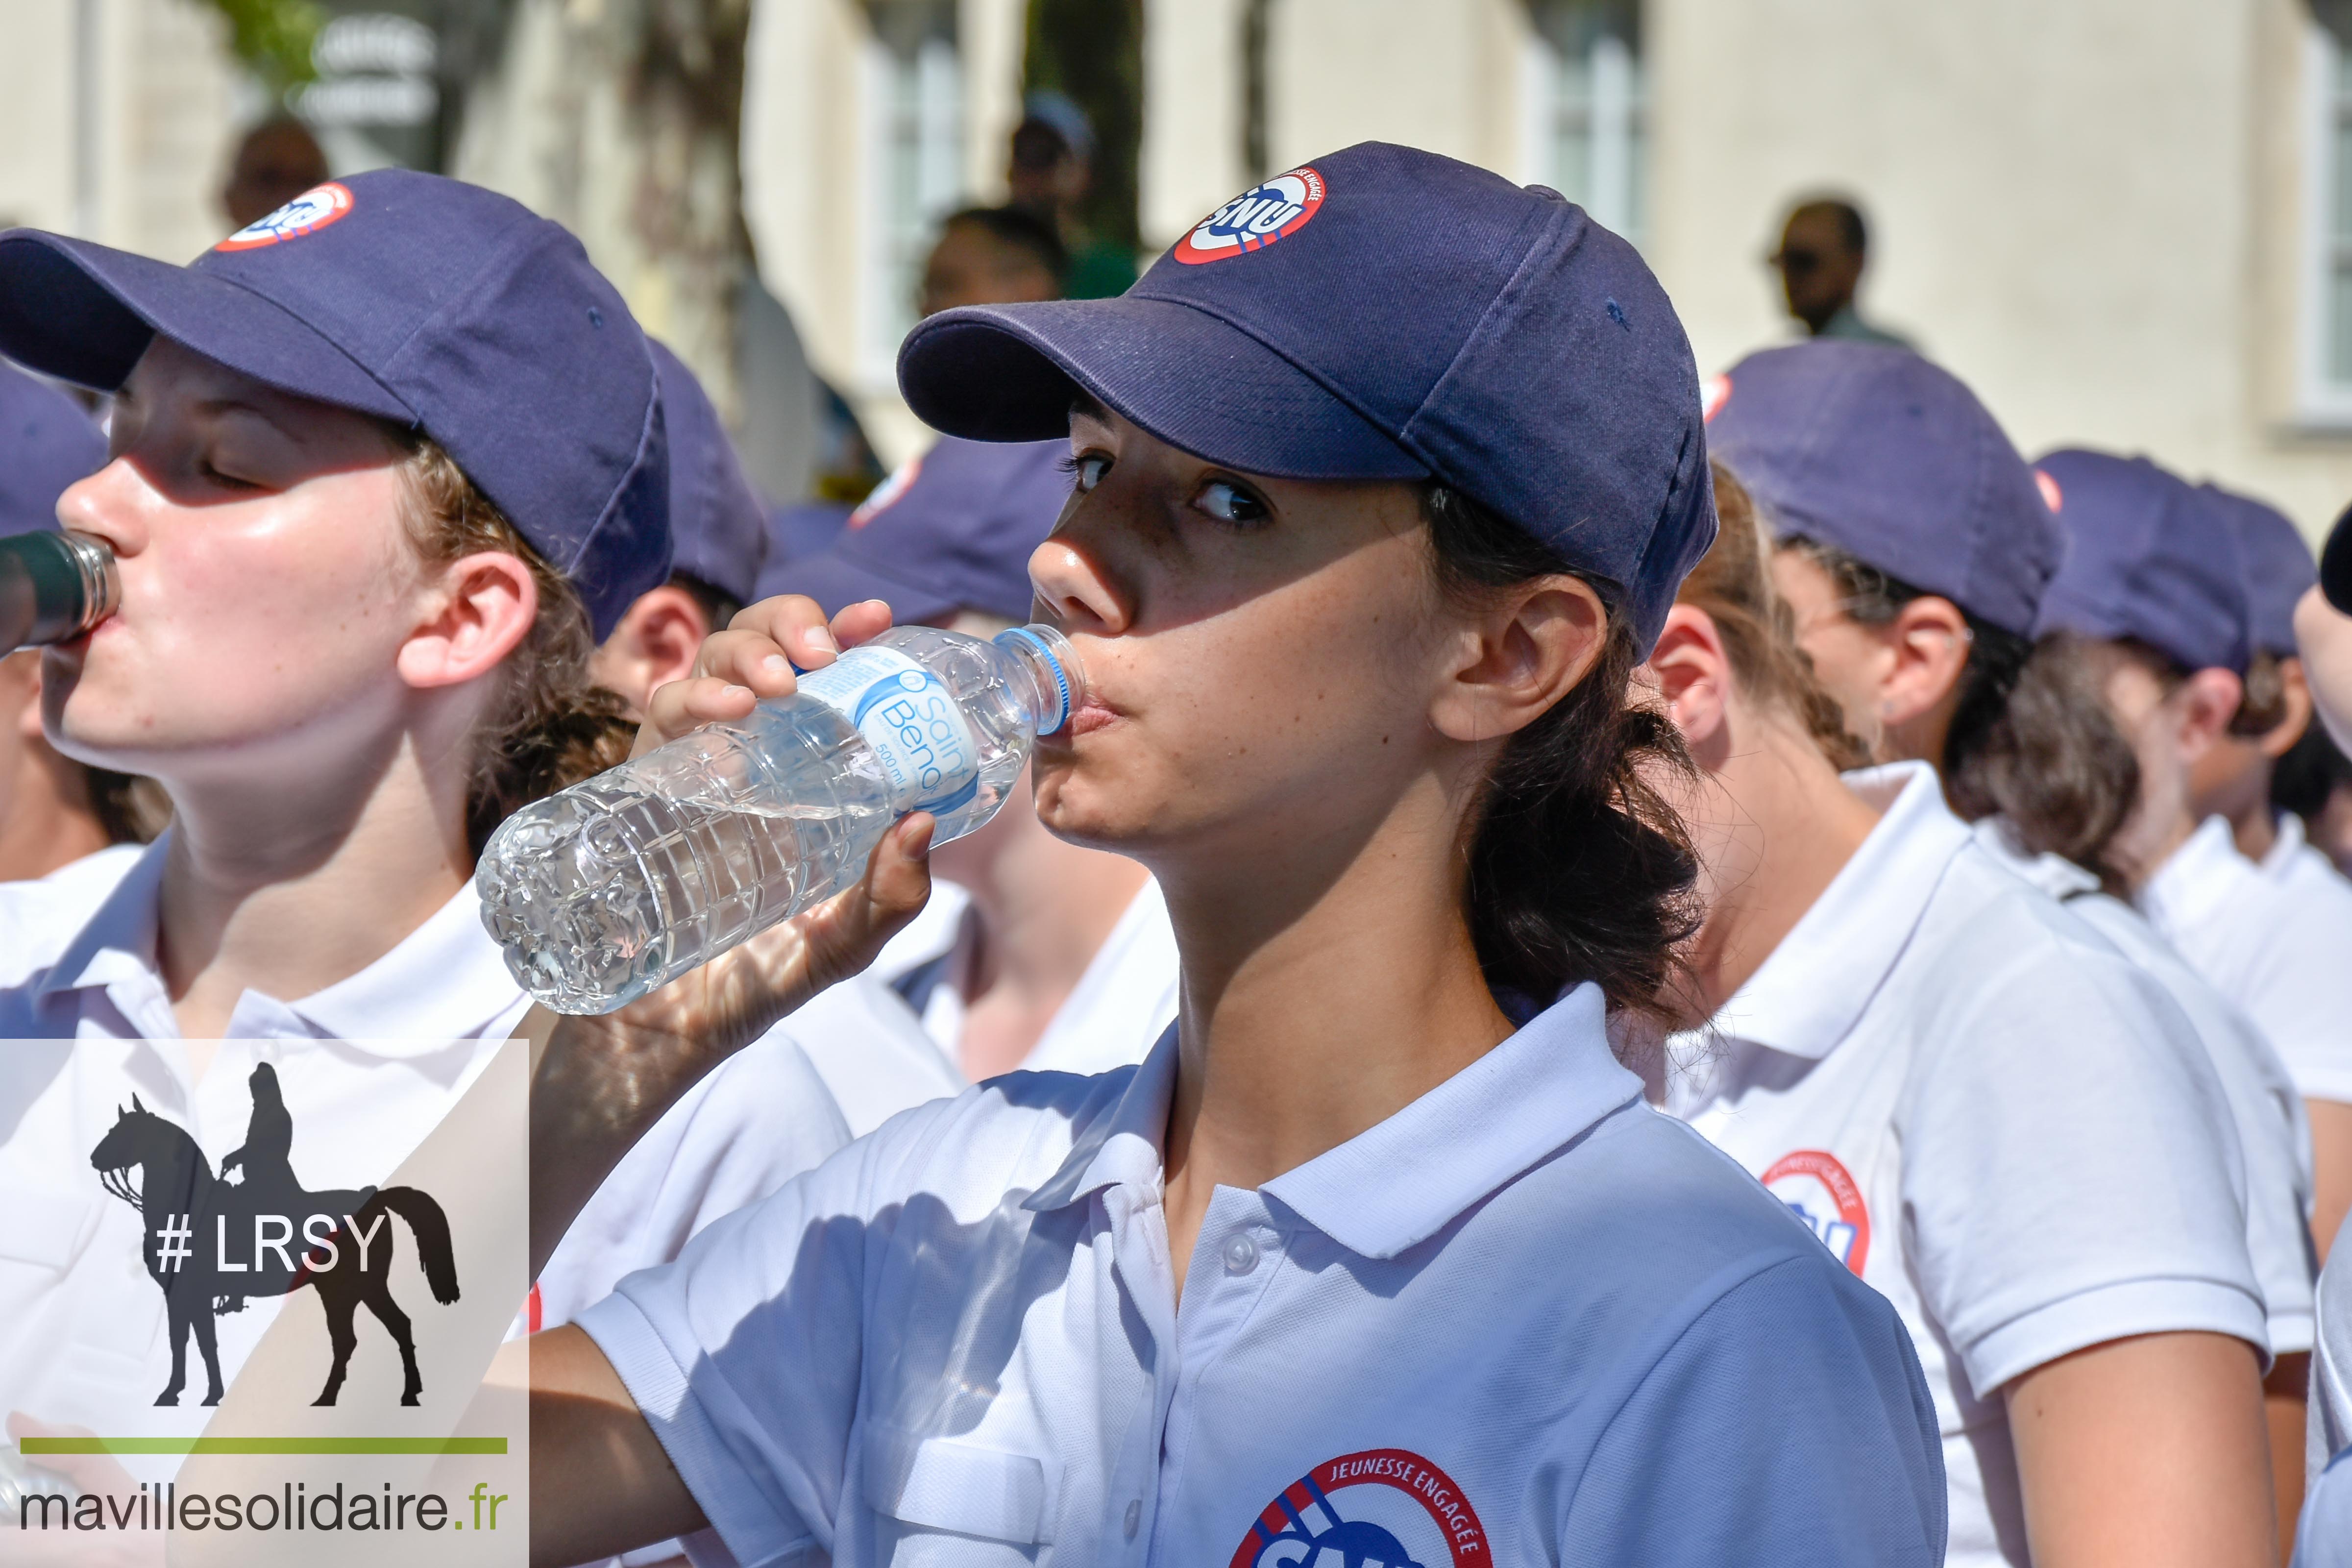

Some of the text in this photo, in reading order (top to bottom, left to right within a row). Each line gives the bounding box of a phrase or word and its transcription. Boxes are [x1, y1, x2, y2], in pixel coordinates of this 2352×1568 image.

[1197, 197, 1303, 234] SNU
[875, 742, 898, 769] 500
[889, 767, 906, 785] ml
[881, 699, 941, 790] Beno
[1330, 1457, 1417, 1482] JEUNESSE
[1413, 1470, 1478, 1555] ENGAGÉE
